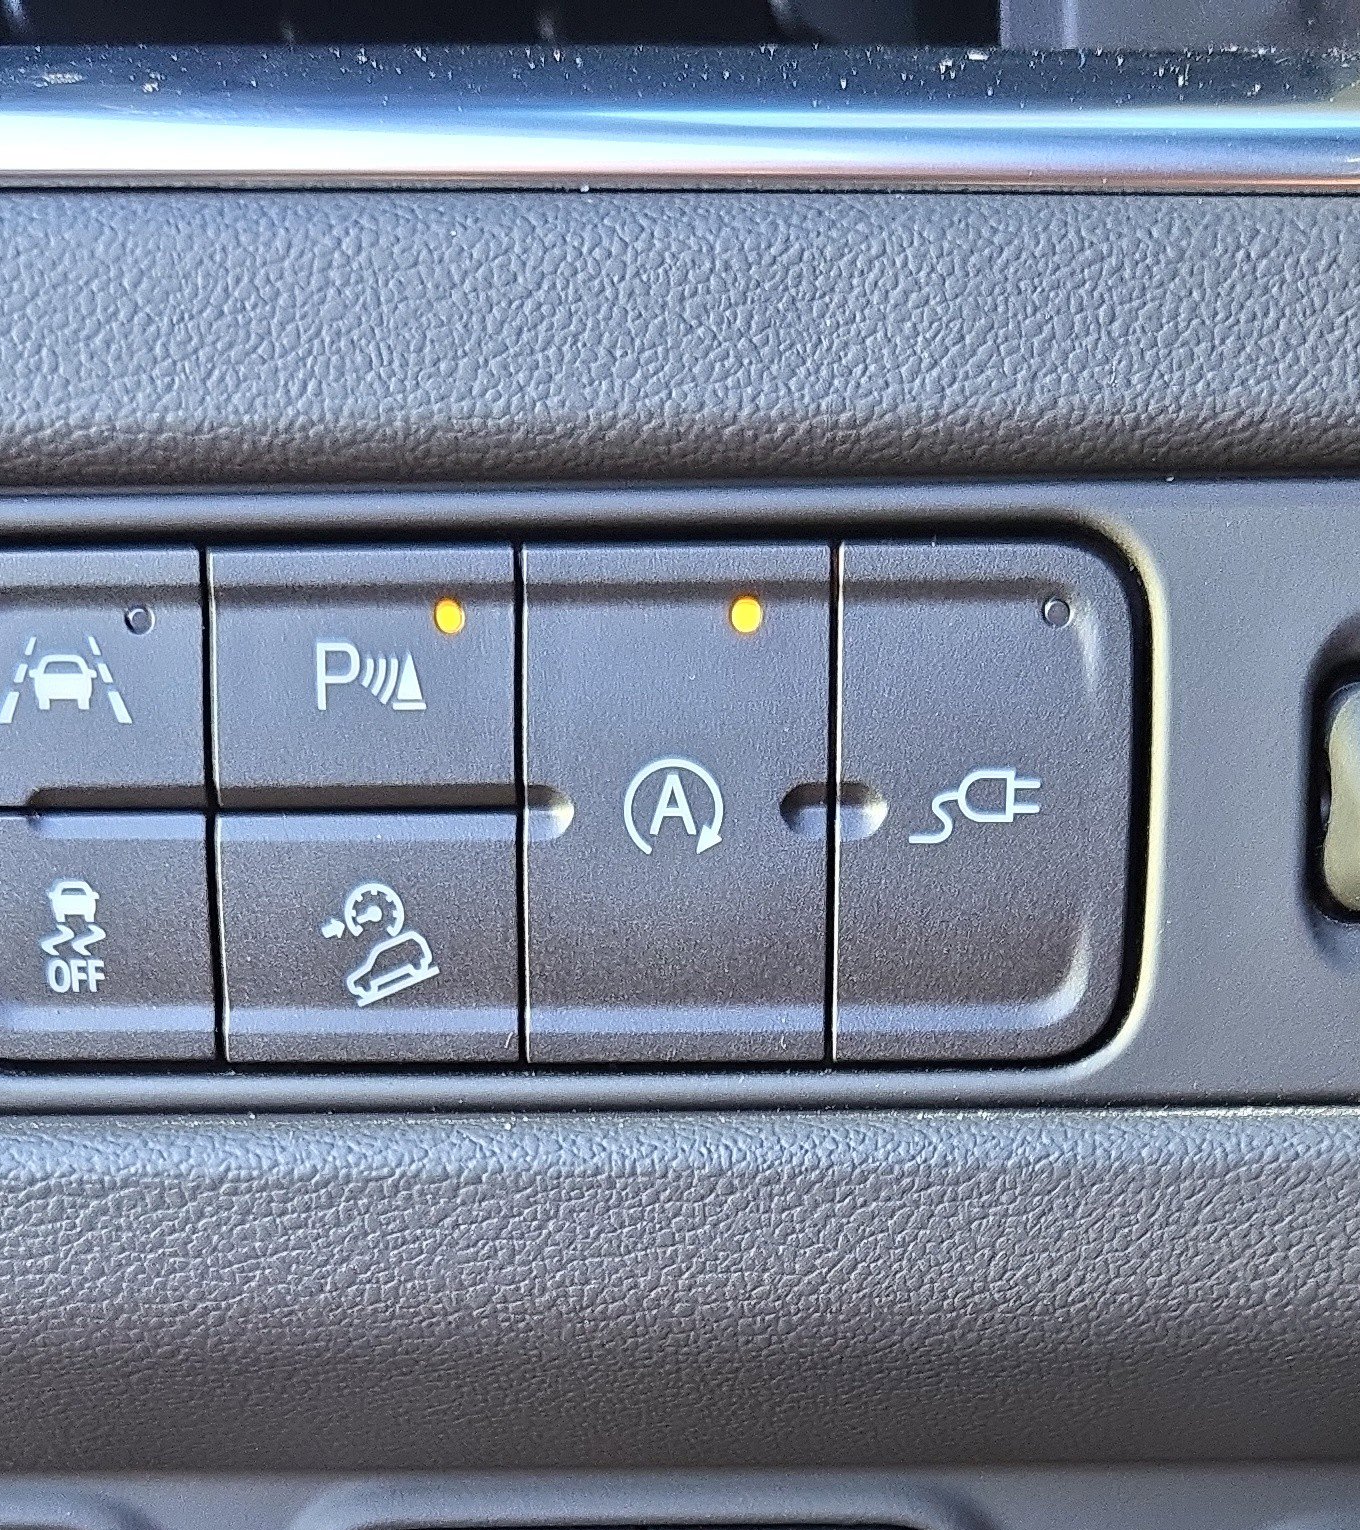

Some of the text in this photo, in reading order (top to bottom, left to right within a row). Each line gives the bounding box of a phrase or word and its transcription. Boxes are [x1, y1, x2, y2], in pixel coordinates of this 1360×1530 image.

[316, 641, 360, 711] P
[648, 773, 699, 837] A
[47, 958, 106, 994] OFF
